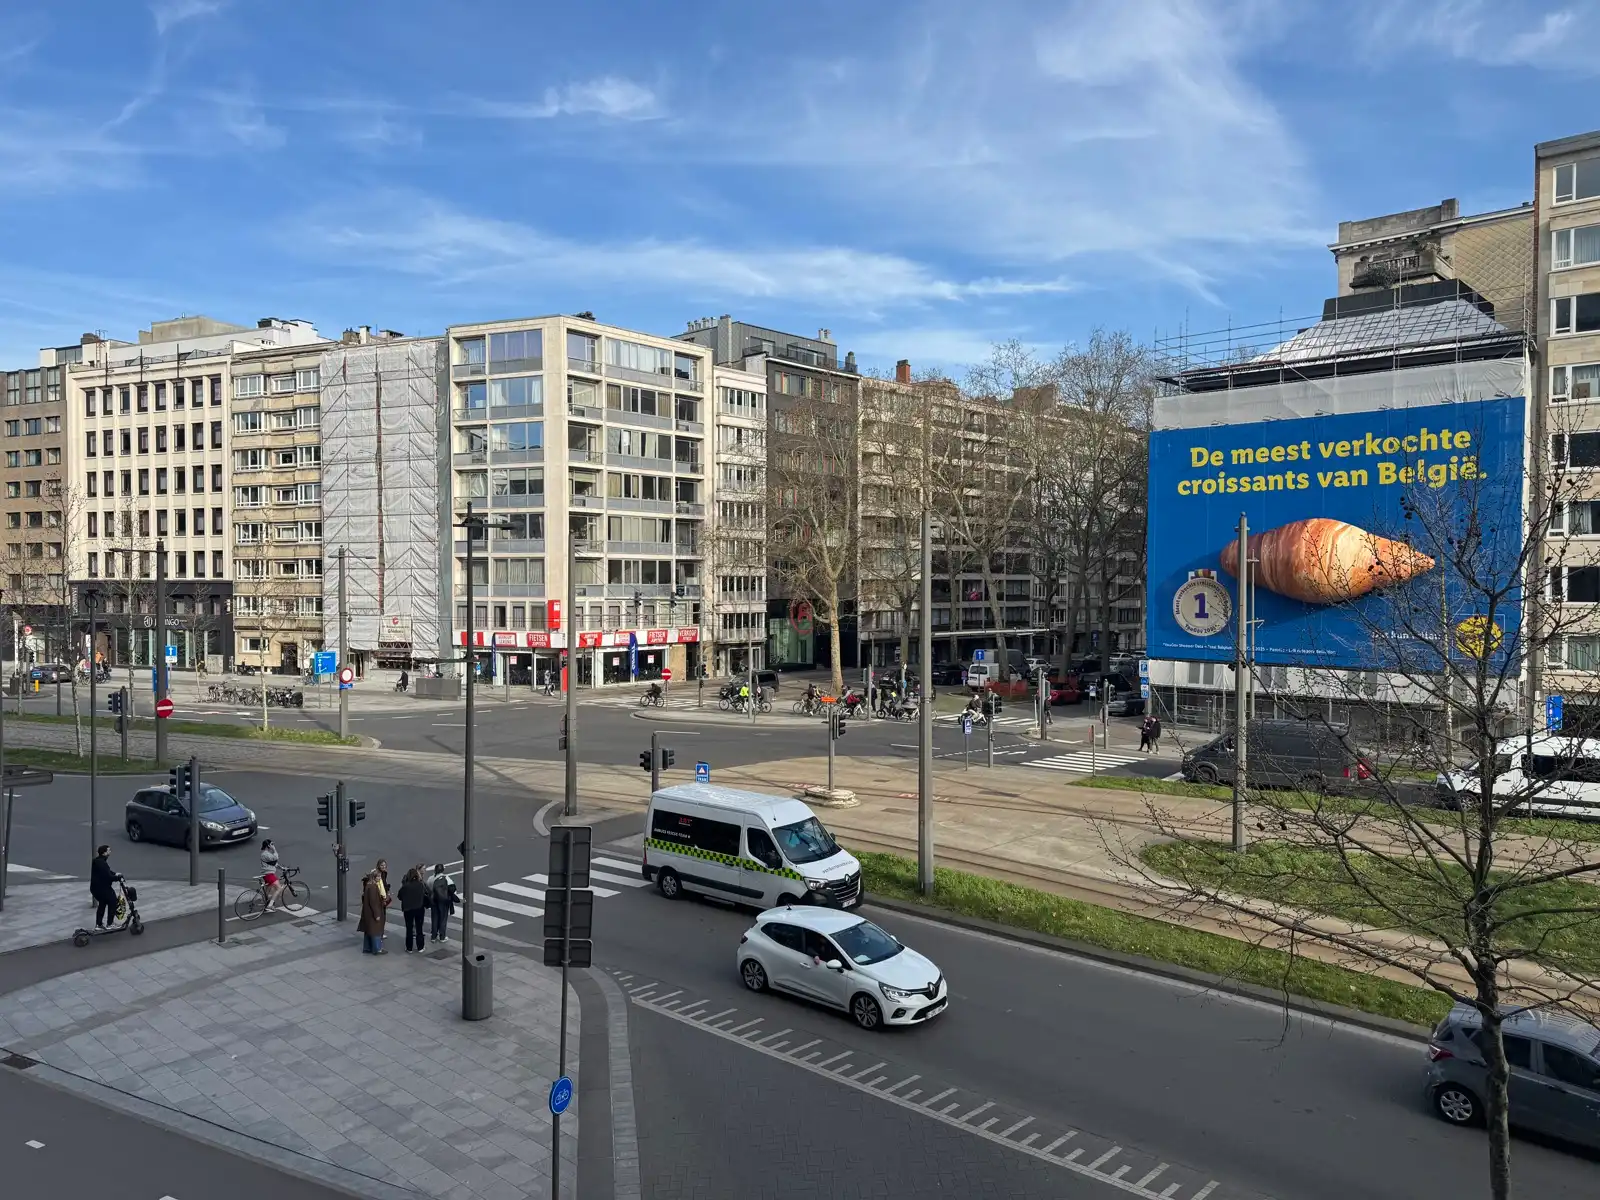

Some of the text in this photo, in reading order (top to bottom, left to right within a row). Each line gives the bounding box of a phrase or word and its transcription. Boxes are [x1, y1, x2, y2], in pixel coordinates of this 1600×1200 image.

[1191, 428, 1471, 467] De meest verkochte
[1178, 455, 1488, 495] croissants van België.
[1193, 592, 1209, 619] 1
[529, 633, 548, 642] FIETSEN
[648, 631, 666, 639] FIETSEN
